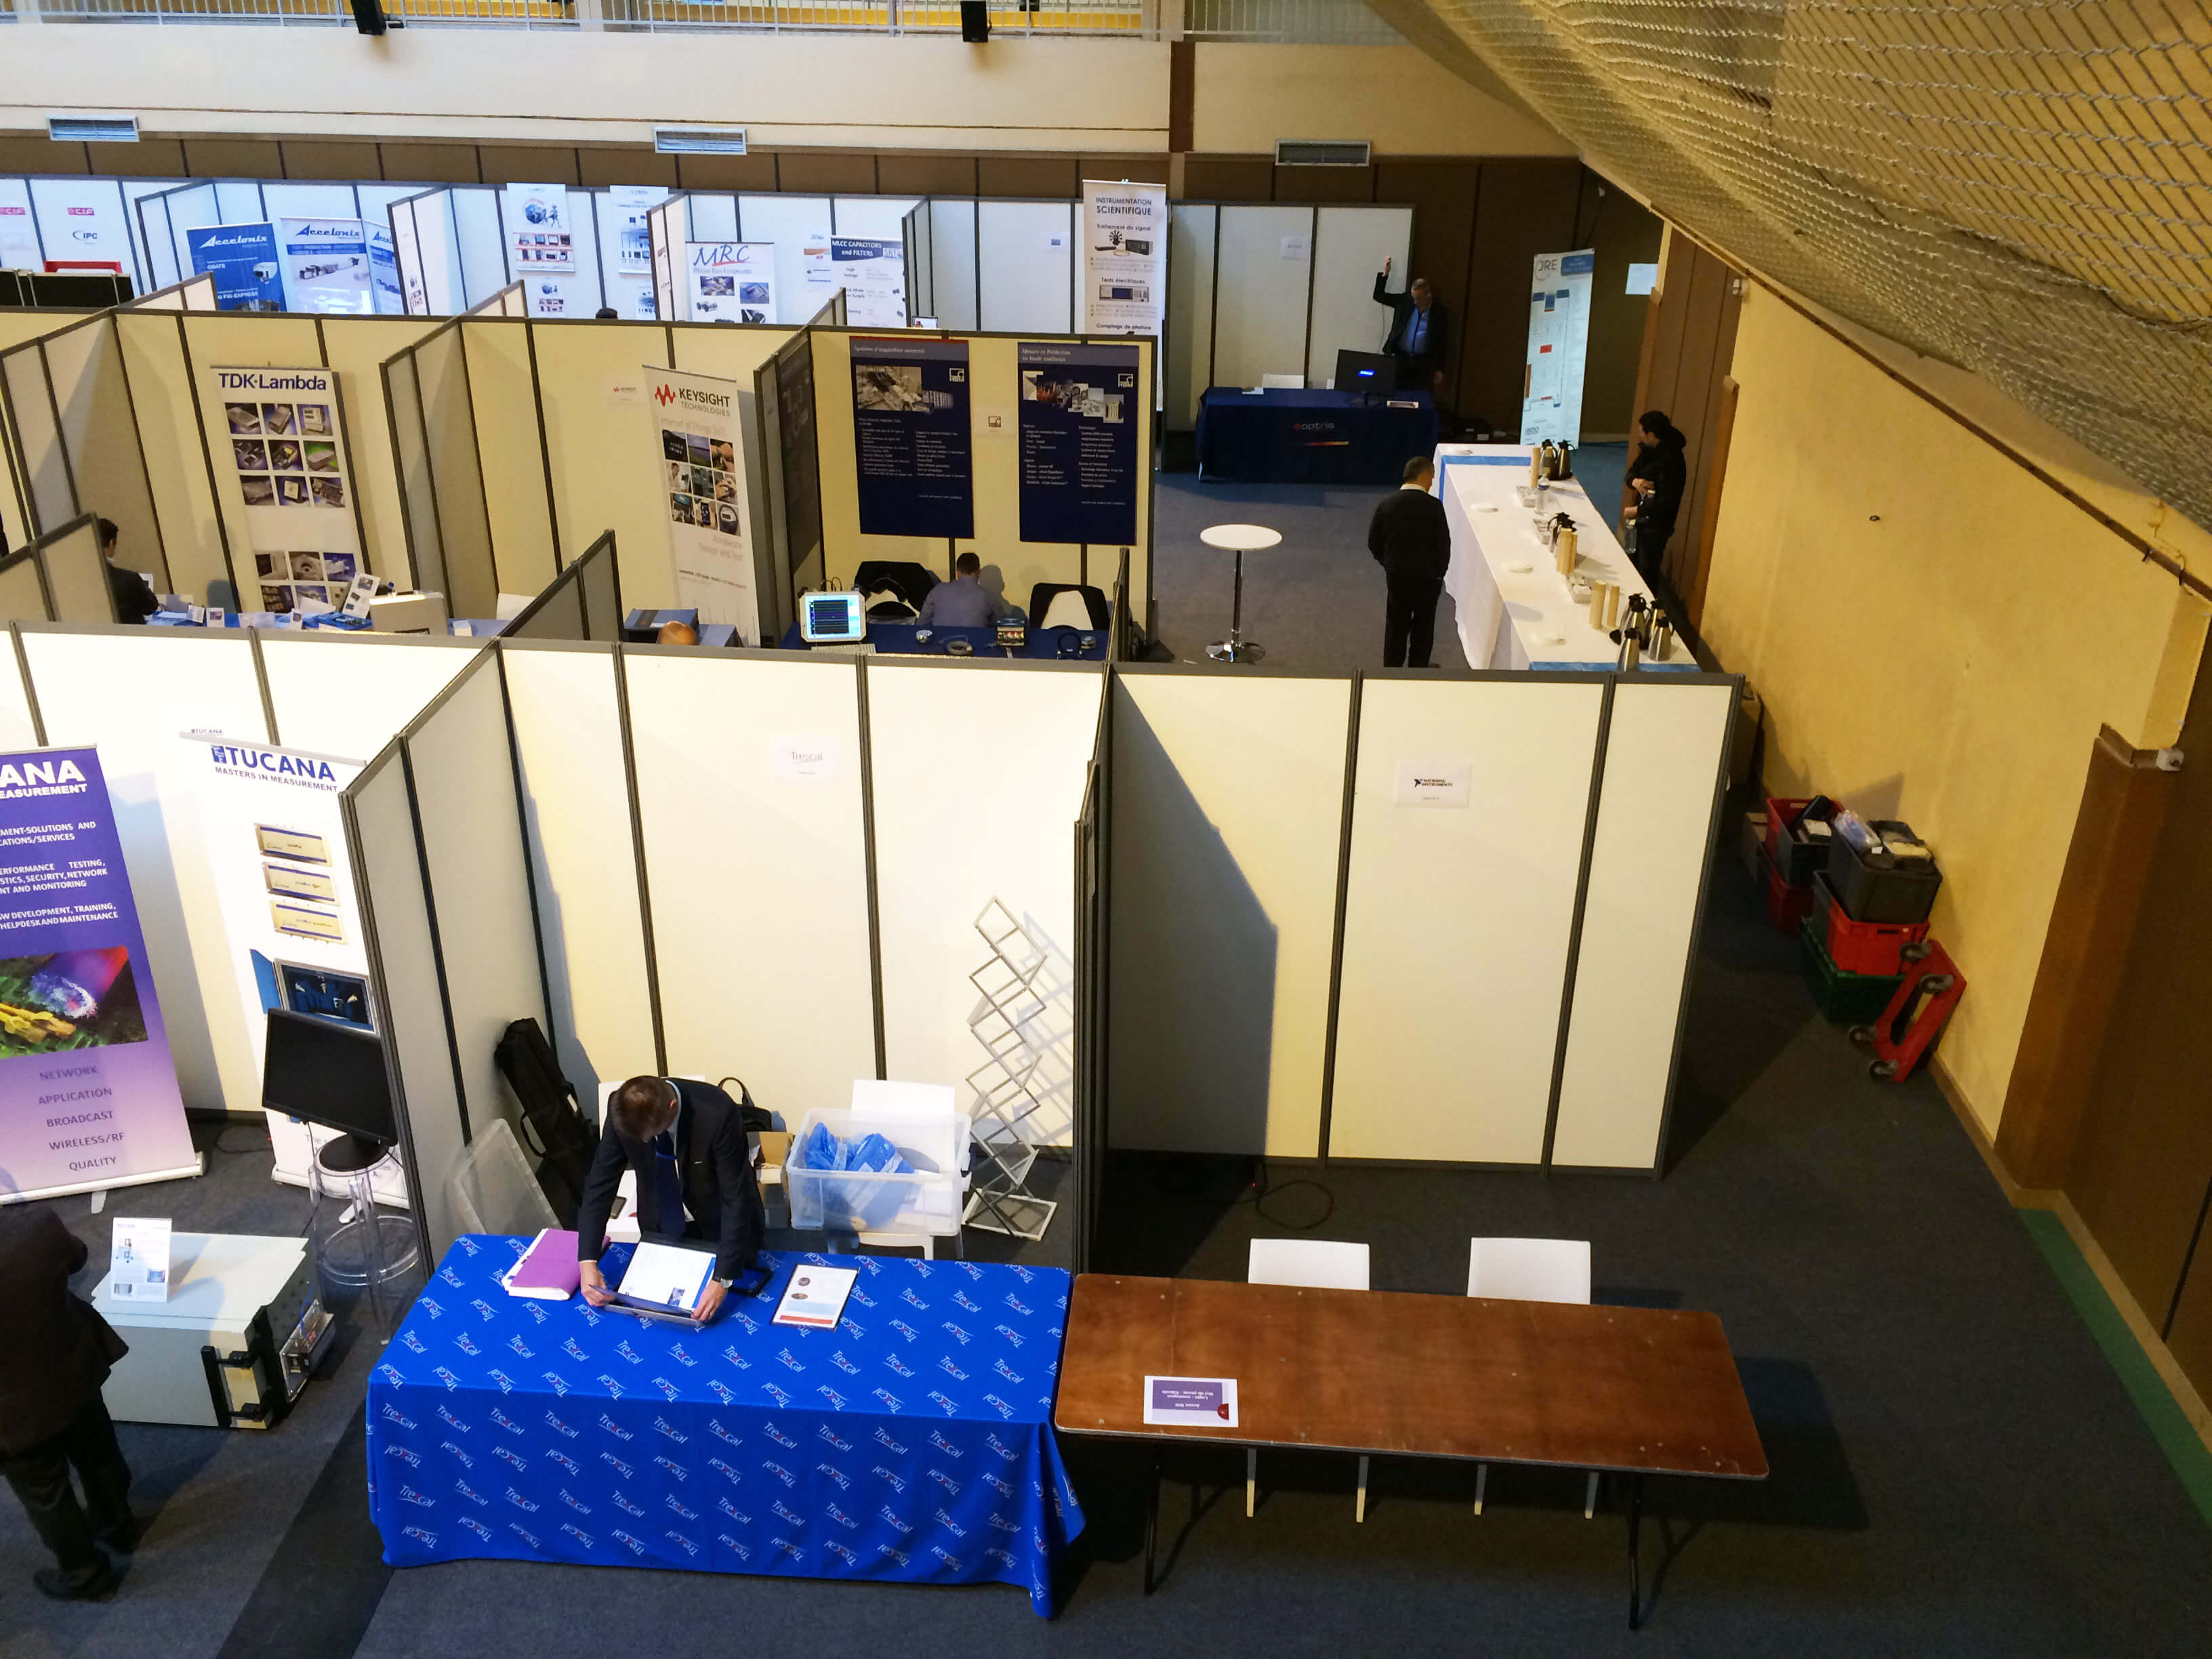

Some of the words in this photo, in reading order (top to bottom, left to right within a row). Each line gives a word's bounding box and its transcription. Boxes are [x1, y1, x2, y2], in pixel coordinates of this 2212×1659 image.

[1096, 197, 1152, 206] INSTRUMENTATION
[1097, 205, 1151, 216] SCIENTIFIQUE
[295, 224, 360, 237] Accelonix
[199, 235, 268, 249] Accelonix
[848, 241, 882, 249] CAPACITORS
[693, 243, 750, 266] MRC
[678, 388, 731, 408] KEYSIGHT
[680, 401, 731, 417] TECHNOLOGIES
[225, 746, 337, 782] TUCANA
[215, 766, 256, 779] MASTERS
[259, 773, 268, 781] IN
[270, 775, 337, 792] MEASUREMENT
[78, 821, 96, 830] AND
[66, 868, 108, 879] NETWORK
[13, 885, 31, 894] AND
[33, 880, 87, 891] MONITORING
[41, 916, 60, 926] AND
[59, 911, 119, 924] MAINTENANCE
[39, 1065, 98, 1080] NETWORK
[38, 1087, 112, 1105] APPLICATION
[46, 1110, 114, 1128] BROADCAST
[48, 1132, 125, 1151] WIRELESS/RF
[68, 1155, 117, 1172] QUALITY
